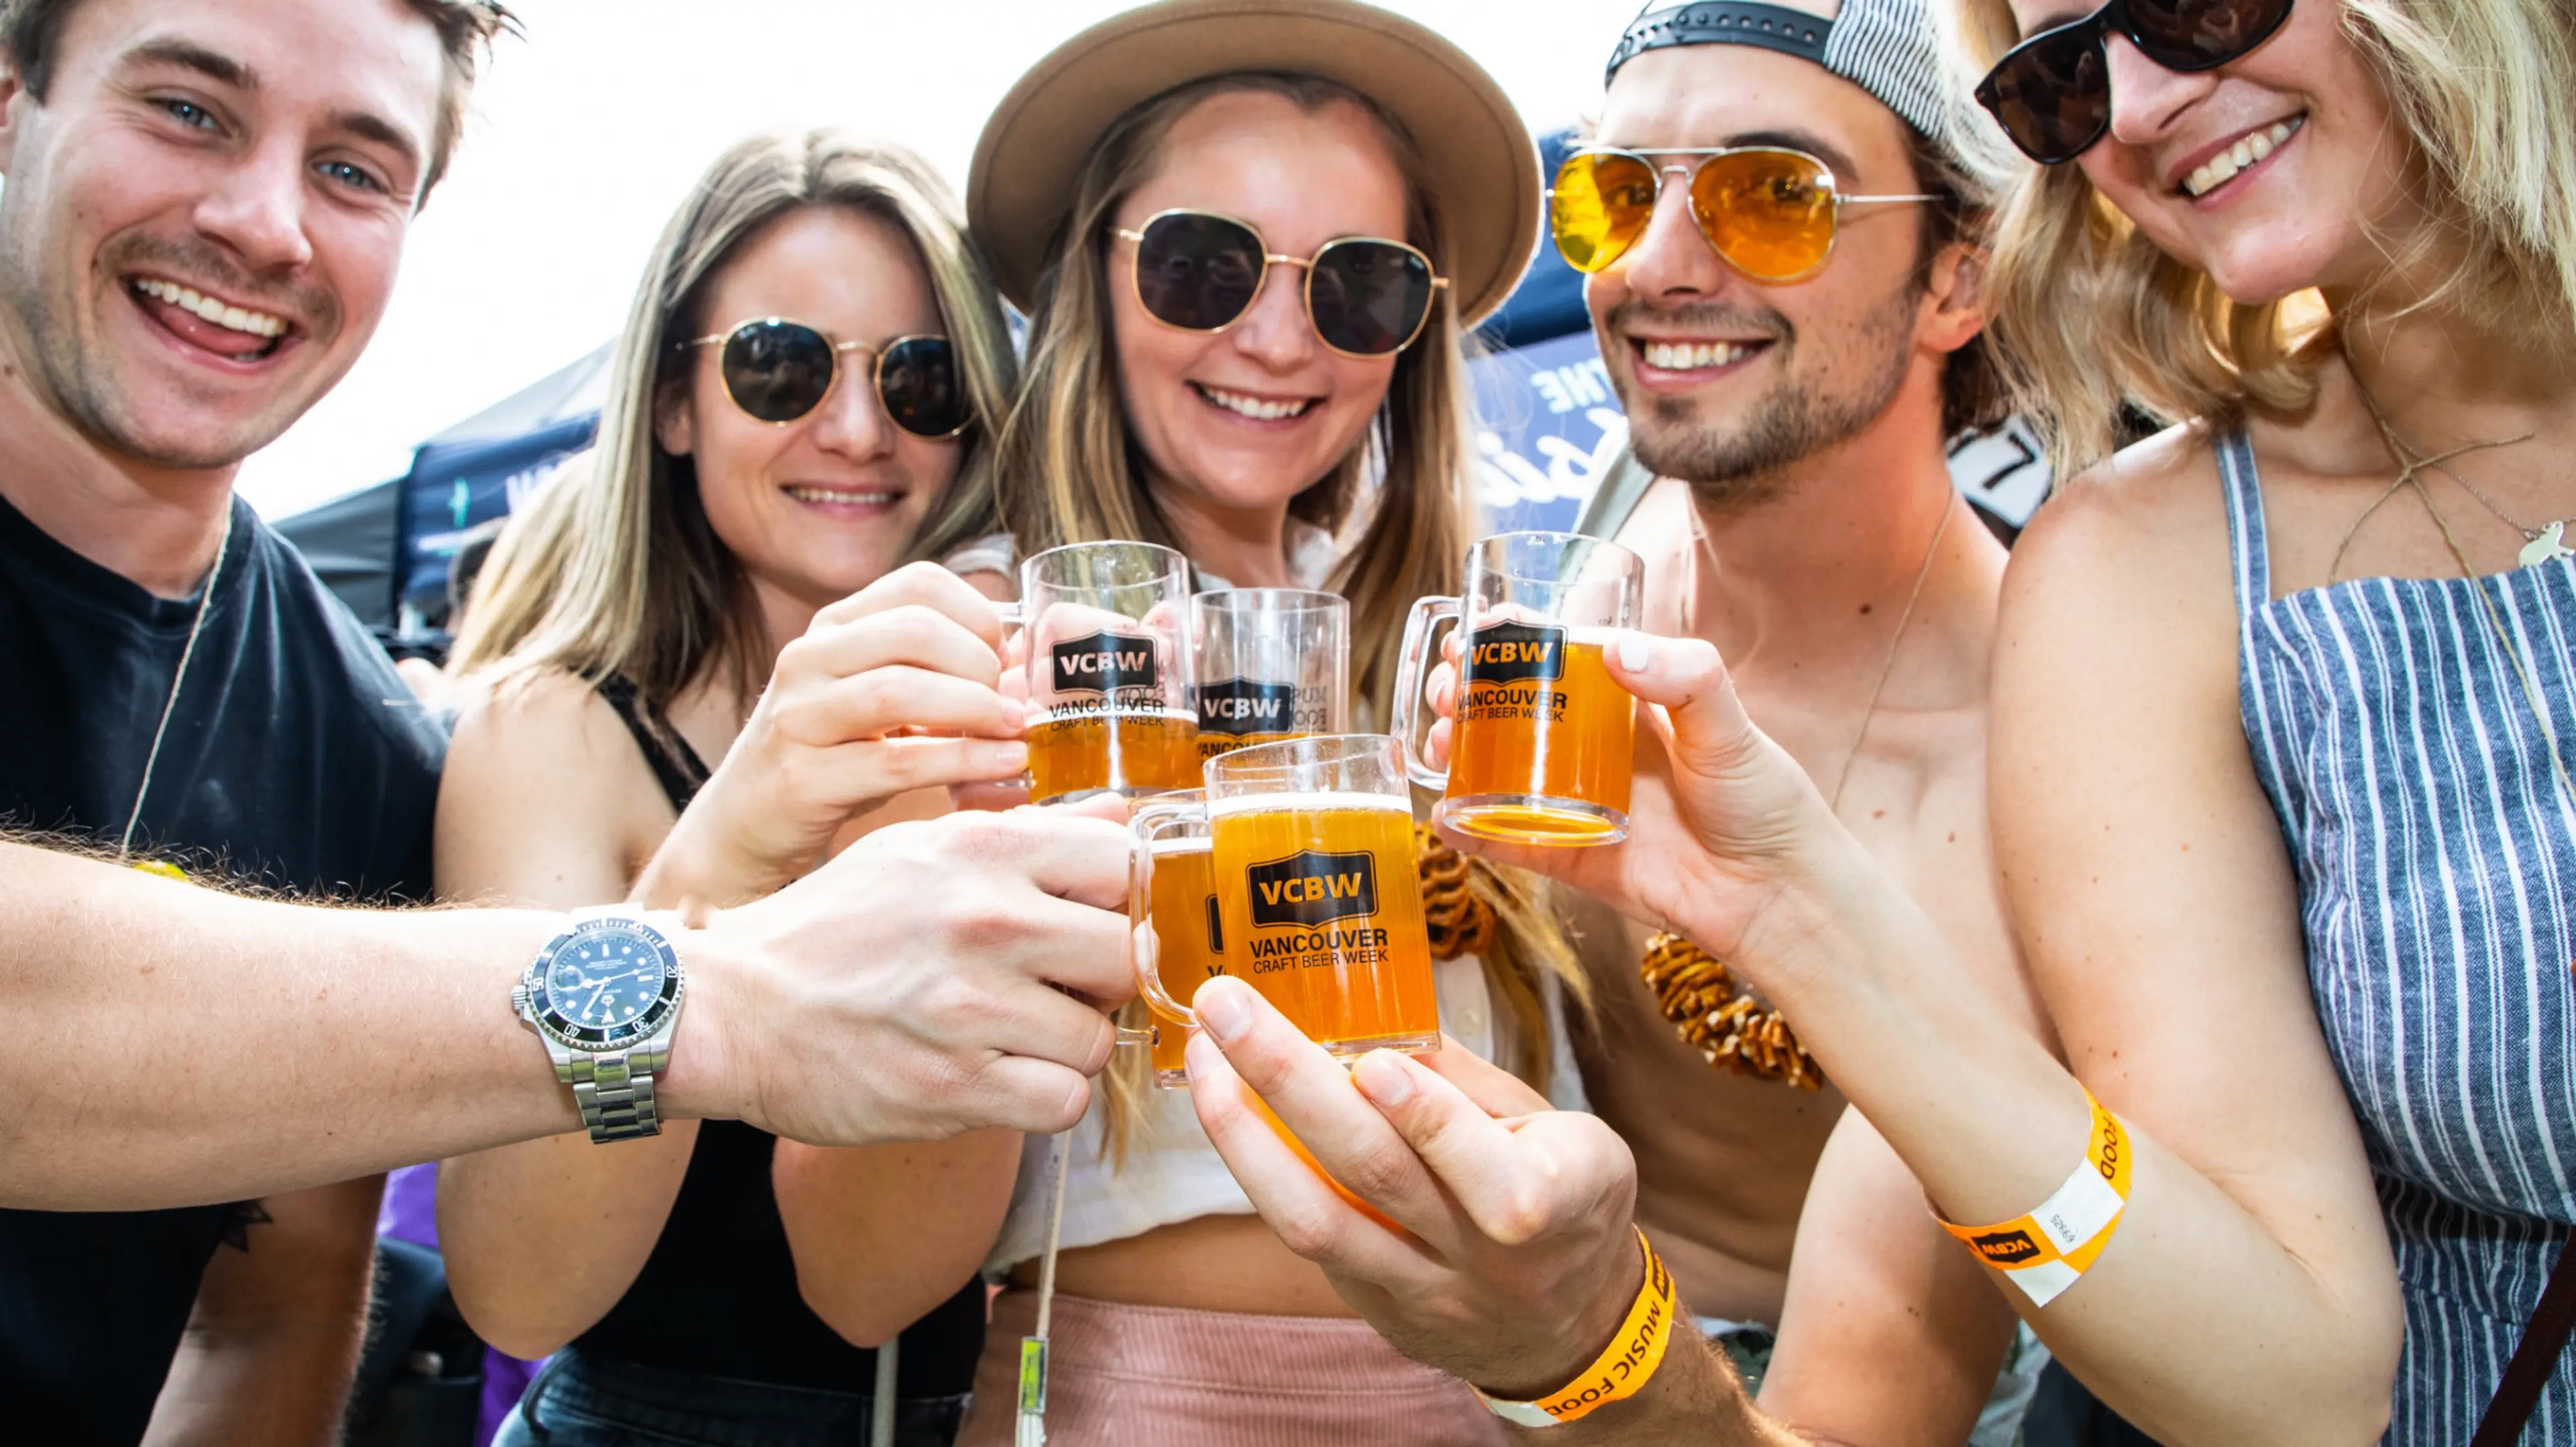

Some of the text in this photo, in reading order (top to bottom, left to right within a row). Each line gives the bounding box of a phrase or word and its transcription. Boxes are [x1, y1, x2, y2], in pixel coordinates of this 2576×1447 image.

[1060, 651, 1148, 676] VCBW
[1470, 641, 1553, 665] VCBW
[1049, 697, 1167, 718] VANCOUVER
[1204, 698, 1282, 718] VCBW
[1457, 689, 1568, 710] VANCOUVER
[1488, 707, 1517, 718] BEER
[1051, 717, 1087, 732] CRAFT
[1127, 715, 1165, 727] WEEK
[1258, 872, 1362, 905] VCBW
[1250, 928, 1388, 958] VANCOUVER
[1253, 949, 1389, 974] CRAFT BEER WEEK
[564, 1024, 581, 1037] 40
[632, 1017, 649, 1032] 30
[2100, 1116, 2117, 1180] FOOD
[1980, 1238, 2031, 1254] VCBW
[1543, 1300, 1660, 1415] MUSIC FOOD
